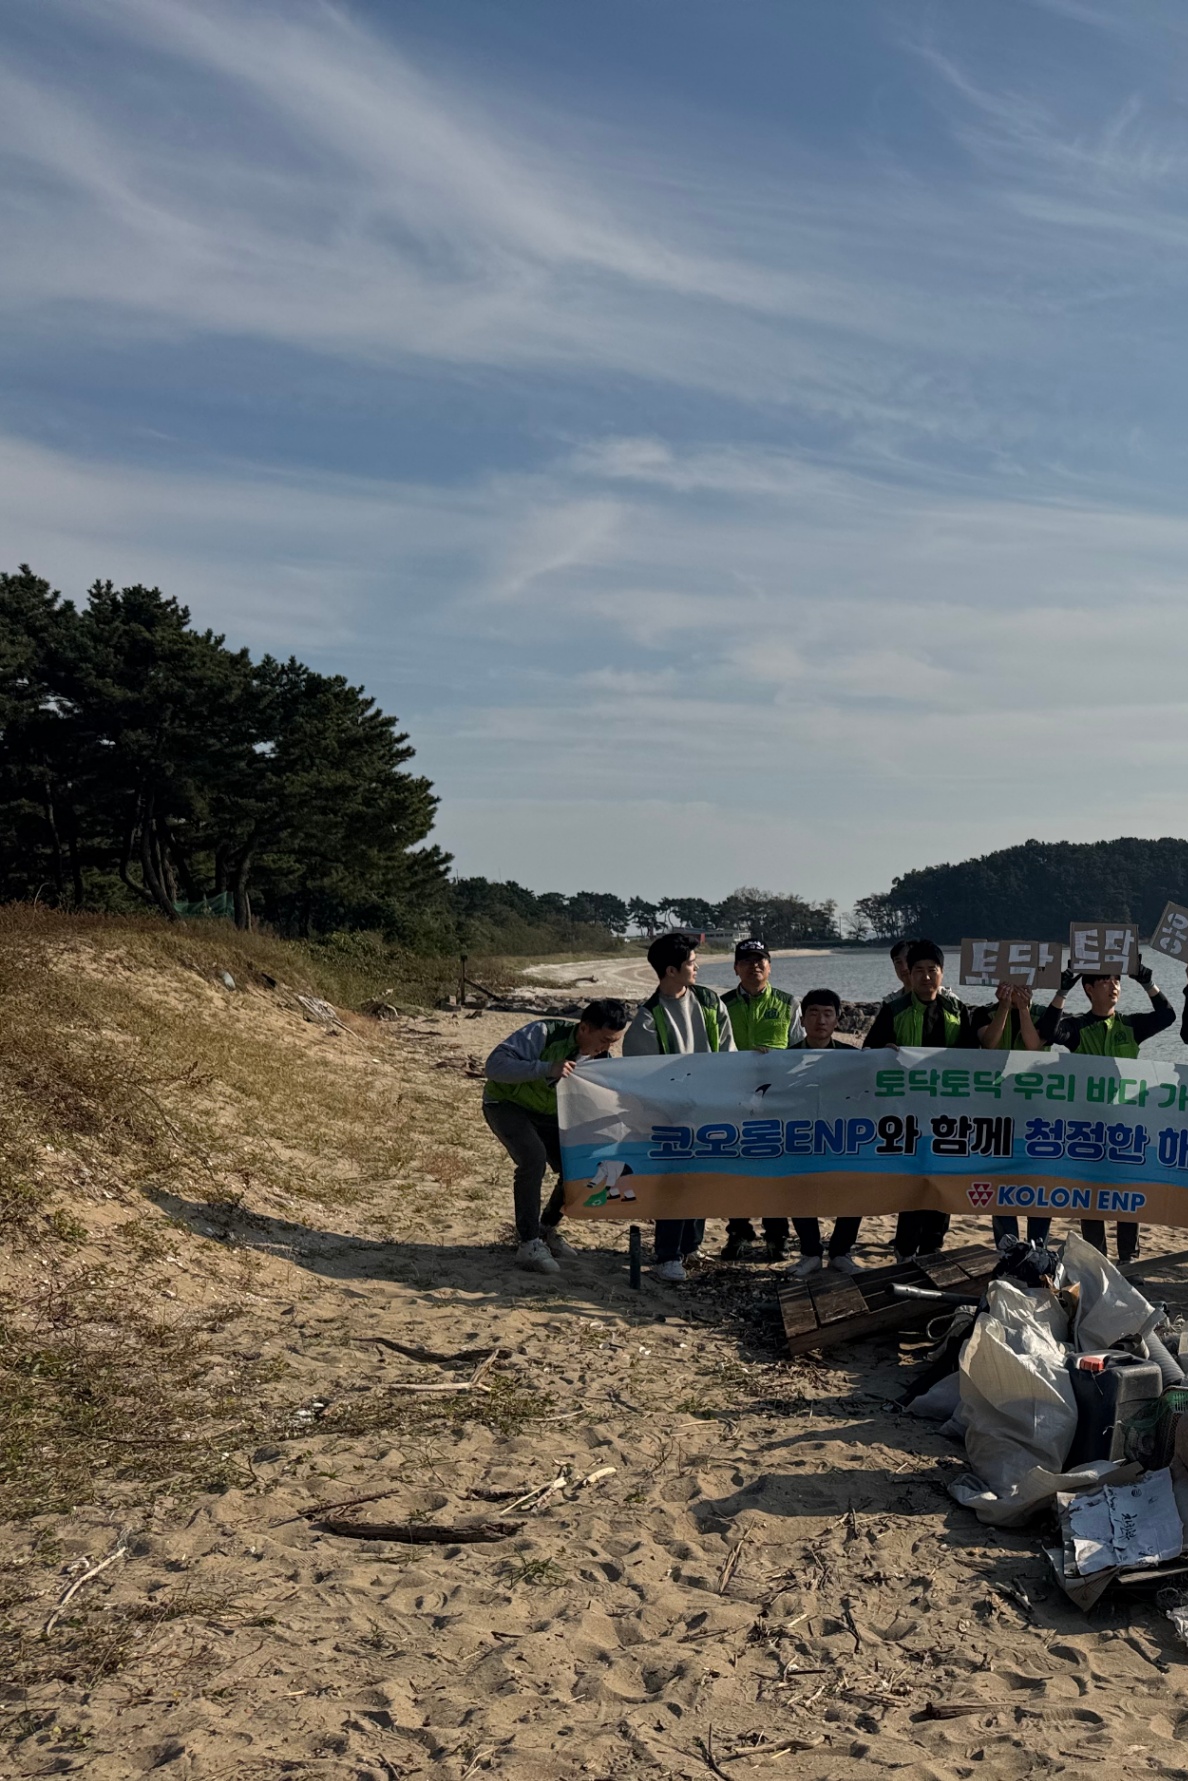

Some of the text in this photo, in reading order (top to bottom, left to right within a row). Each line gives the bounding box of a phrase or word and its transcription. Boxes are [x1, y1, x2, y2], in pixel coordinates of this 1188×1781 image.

[965, 941, 1054, 986] 토닥
[1073, 929, 1134, 974] 토닥
[874, 1068, 1005, 1099] 토닥토닥
[1013, 1072, 1076, 1102] 우리
[1087, 1076, 1149, 1108] 바다
[648, 1114, 922, 1159] 코오롱ENP와
[930, 1114, 1015, 1158] 함께
[1024, 1117, 1148, 1165] 청정한
[997, 1184, 1147, 1213] KOLON ENP
